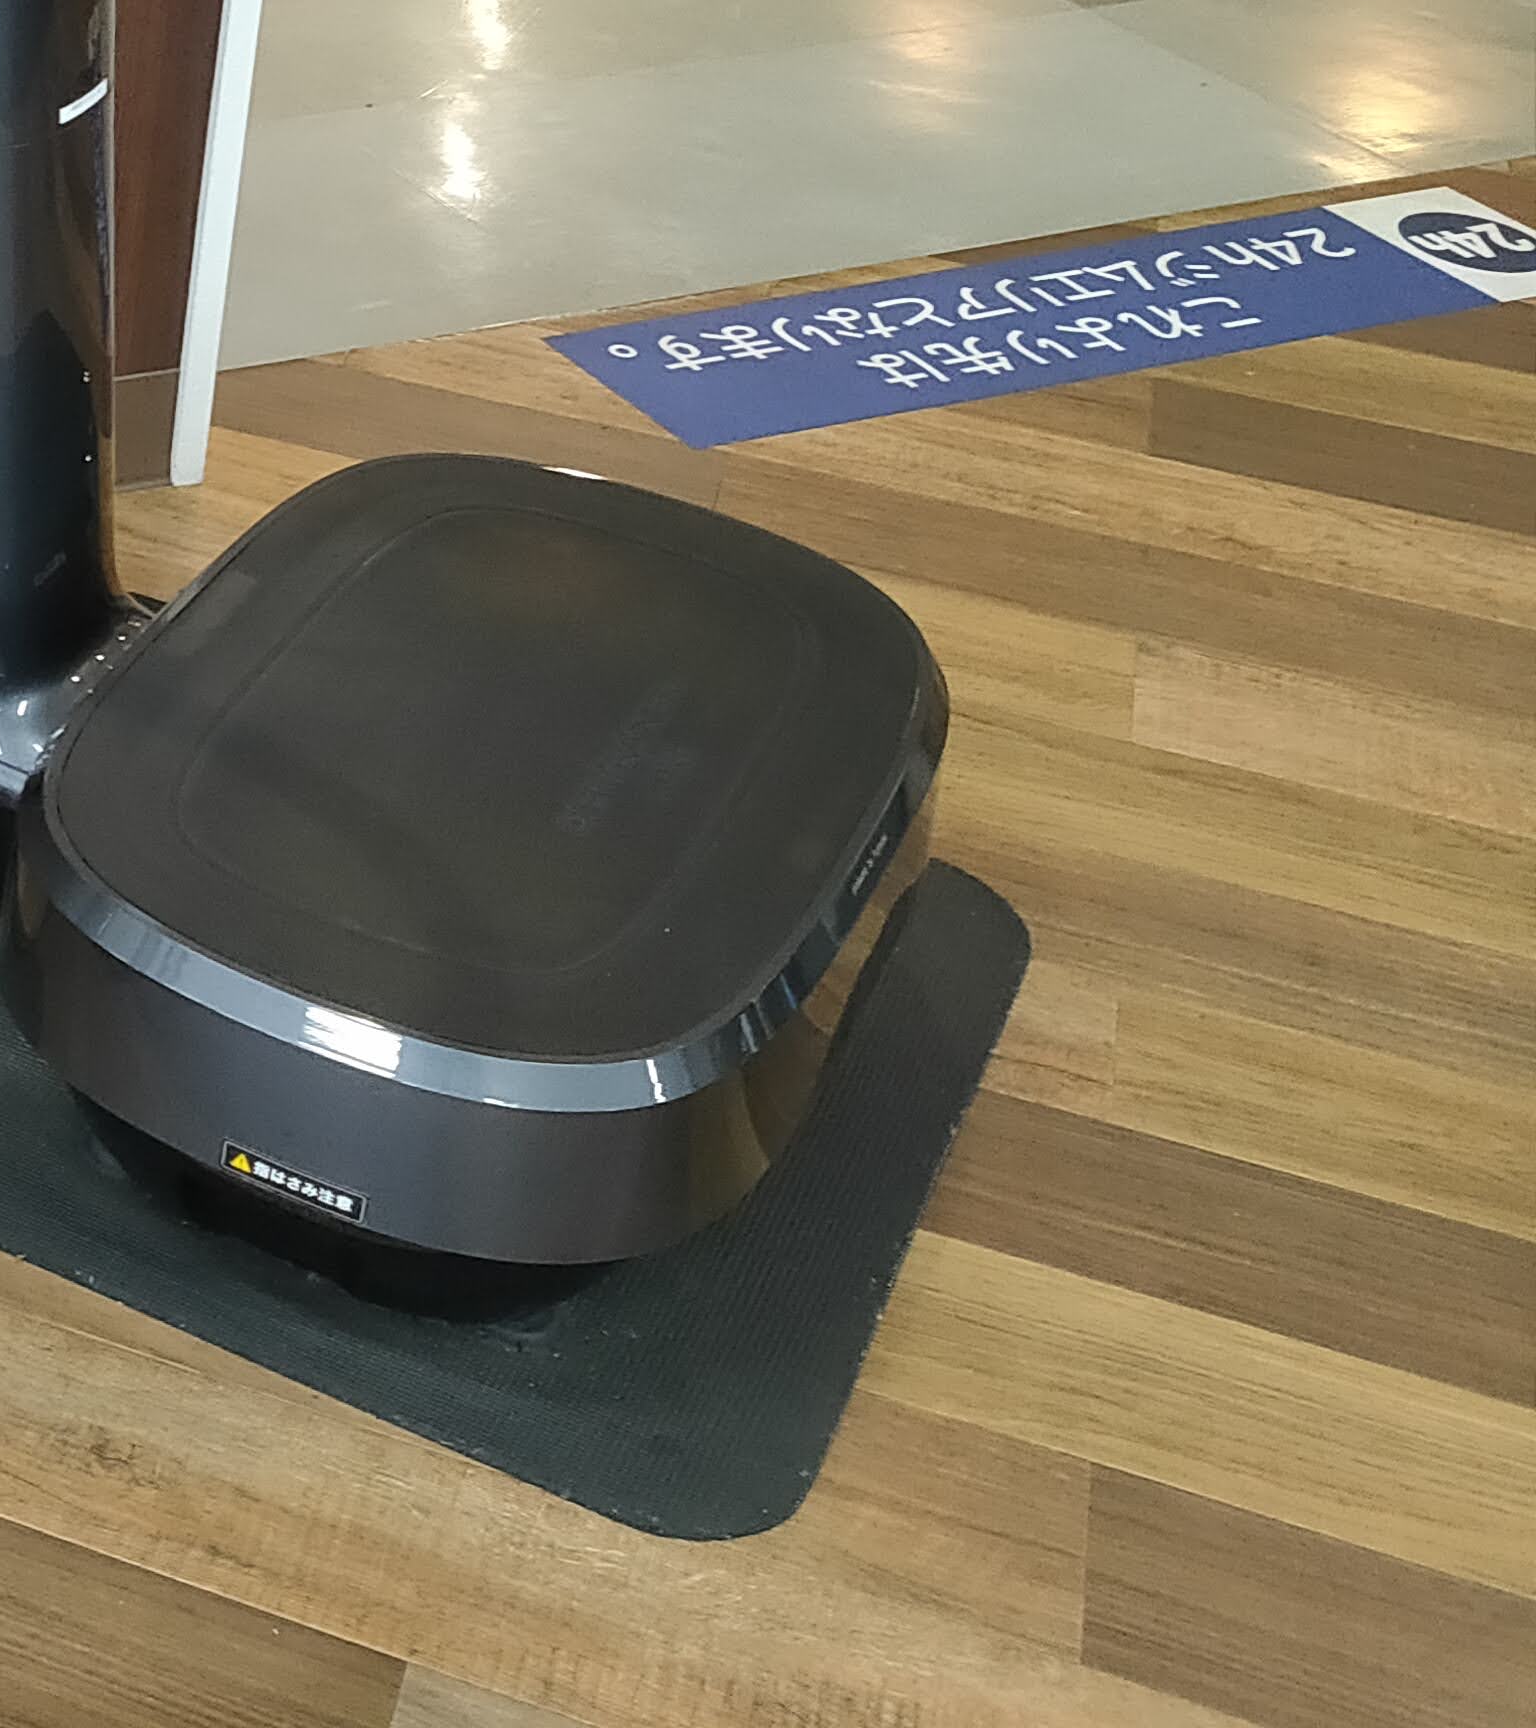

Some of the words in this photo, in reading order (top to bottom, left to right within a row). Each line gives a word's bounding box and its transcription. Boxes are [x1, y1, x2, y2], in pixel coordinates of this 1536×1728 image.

[1408, 223, 1535, 258] 24h
[608, 226, 1358, 373] 24hジムエリアとなります。
[857, 296, 1263, 389] これより先は
